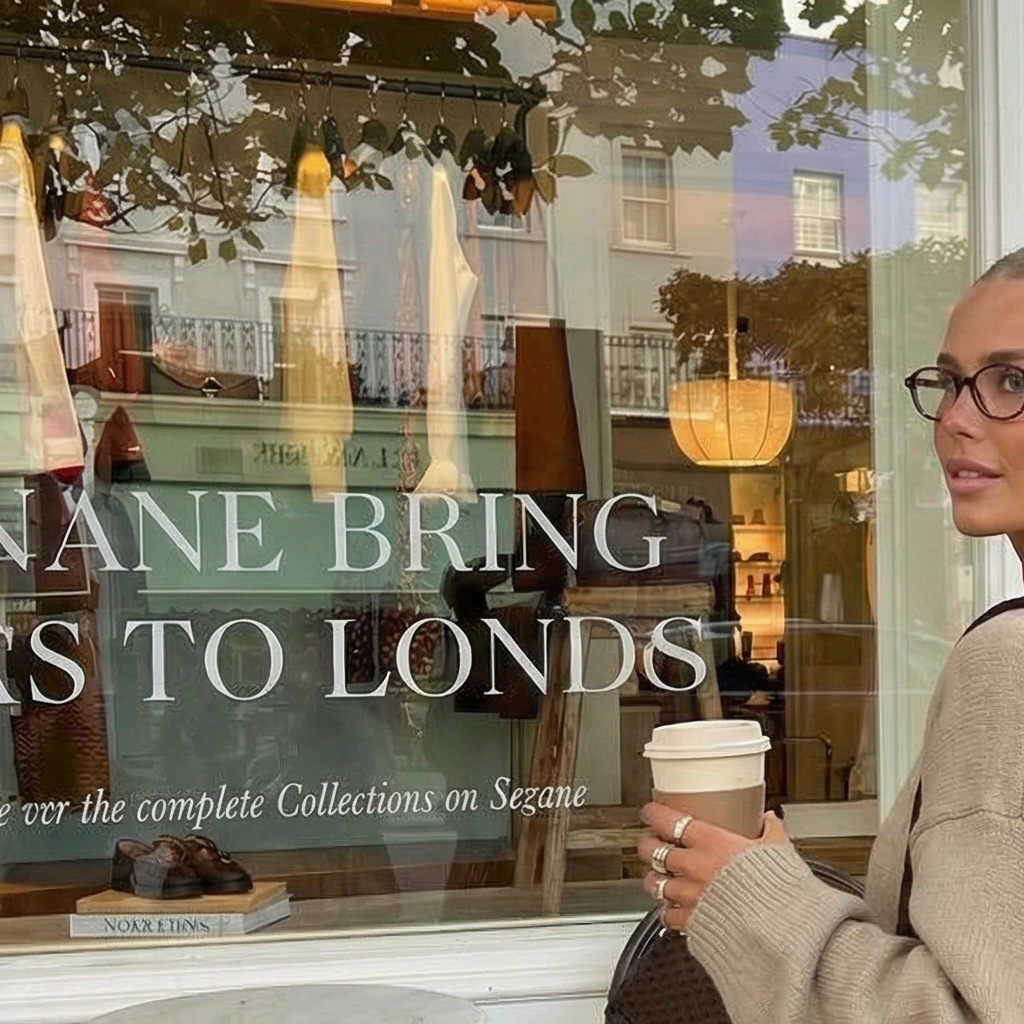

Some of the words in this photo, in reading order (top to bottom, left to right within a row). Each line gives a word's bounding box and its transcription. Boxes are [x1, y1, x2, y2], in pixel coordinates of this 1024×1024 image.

[326, 492, 667, 572] BRING
[123, 618, 284, 701] TO
[324, 616, 708, 698] LONDS
[81, 788, 126, 825] the
[136, 784, 265, 831] complete
[277, 781, 435, 818] Collections
[445, 788, 479, 812] on
